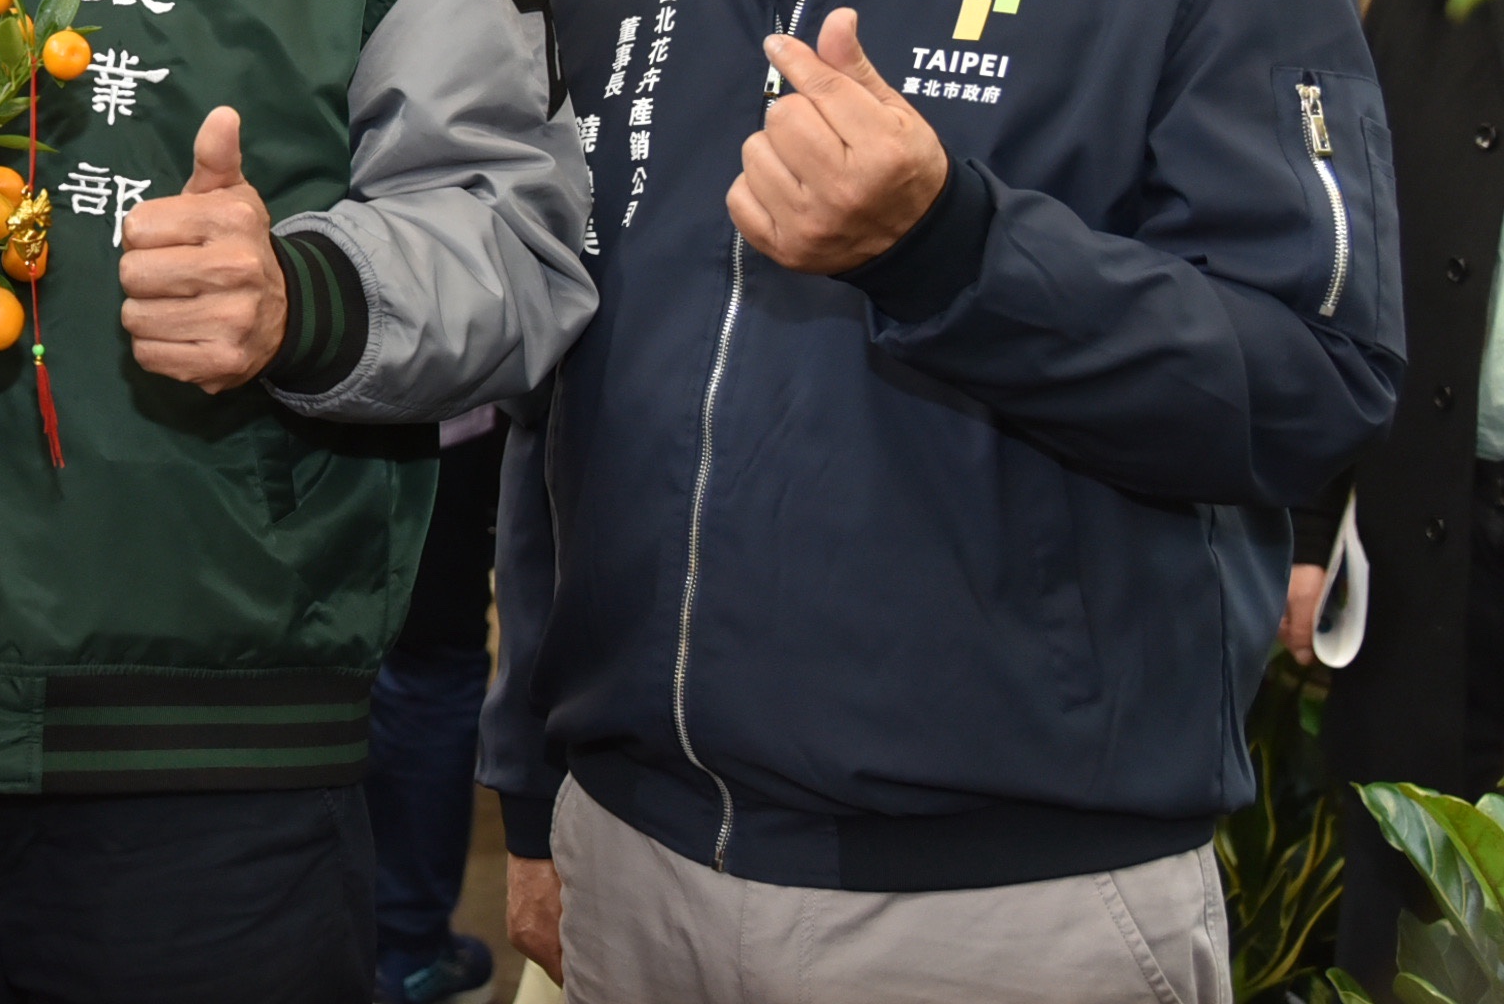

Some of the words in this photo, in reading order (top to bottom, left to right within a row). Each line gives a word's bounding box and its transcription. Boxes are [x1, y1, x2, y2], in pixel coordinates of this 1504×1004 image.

[603, 15, 642, 100] 董事長
[912, 47, 1009, 78] TAIPEI
[902, 76, 1002, 104] 臺北市政府
